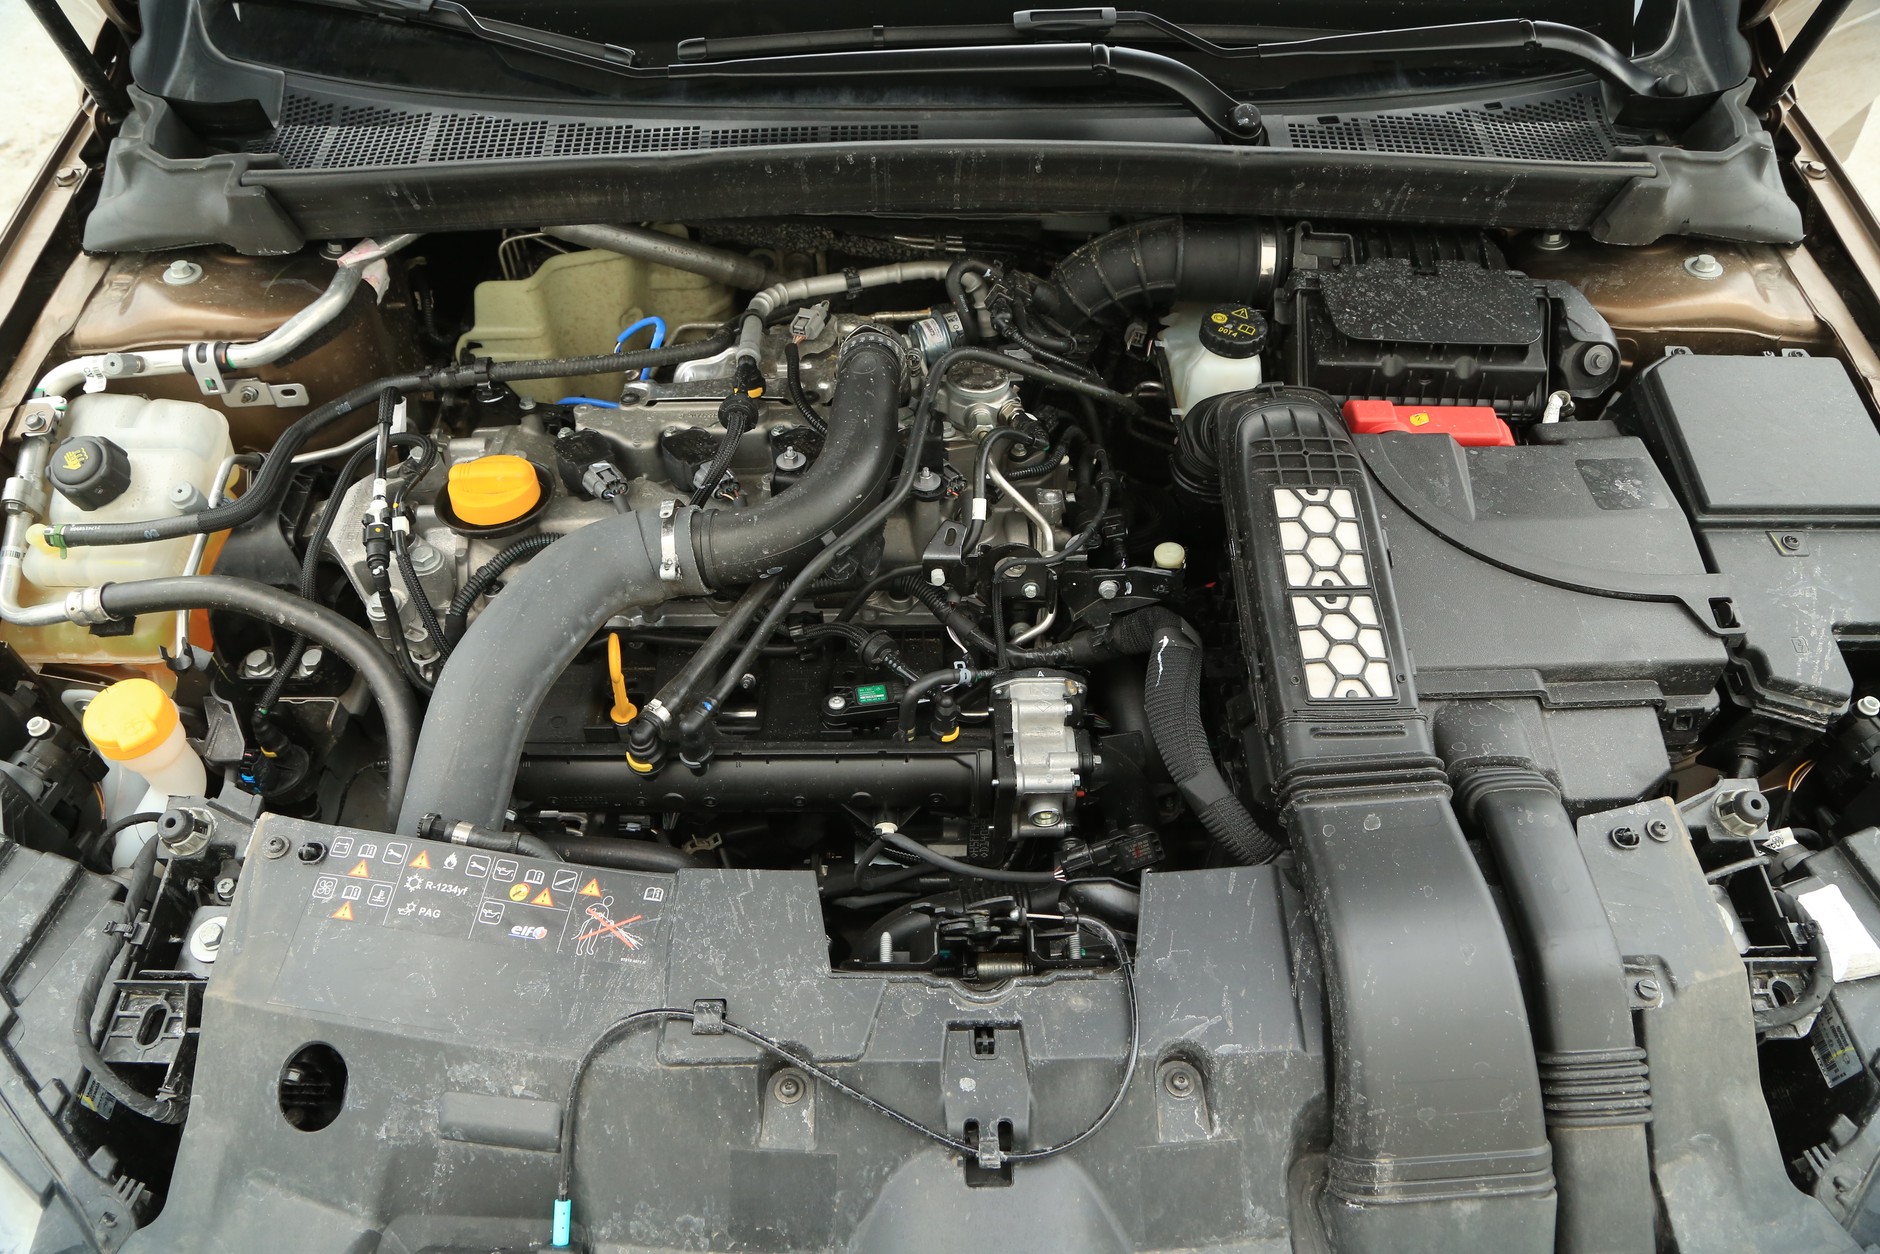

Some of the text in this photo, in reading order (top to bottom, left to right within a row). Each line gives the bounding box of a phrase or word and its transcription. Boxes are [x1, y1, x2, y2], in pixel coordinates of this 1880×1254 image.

[1218, 326, 1233, 336] DOT
[425, 881, 469, 896] R-1234yf
[418, 907, 441, 918] PAG
